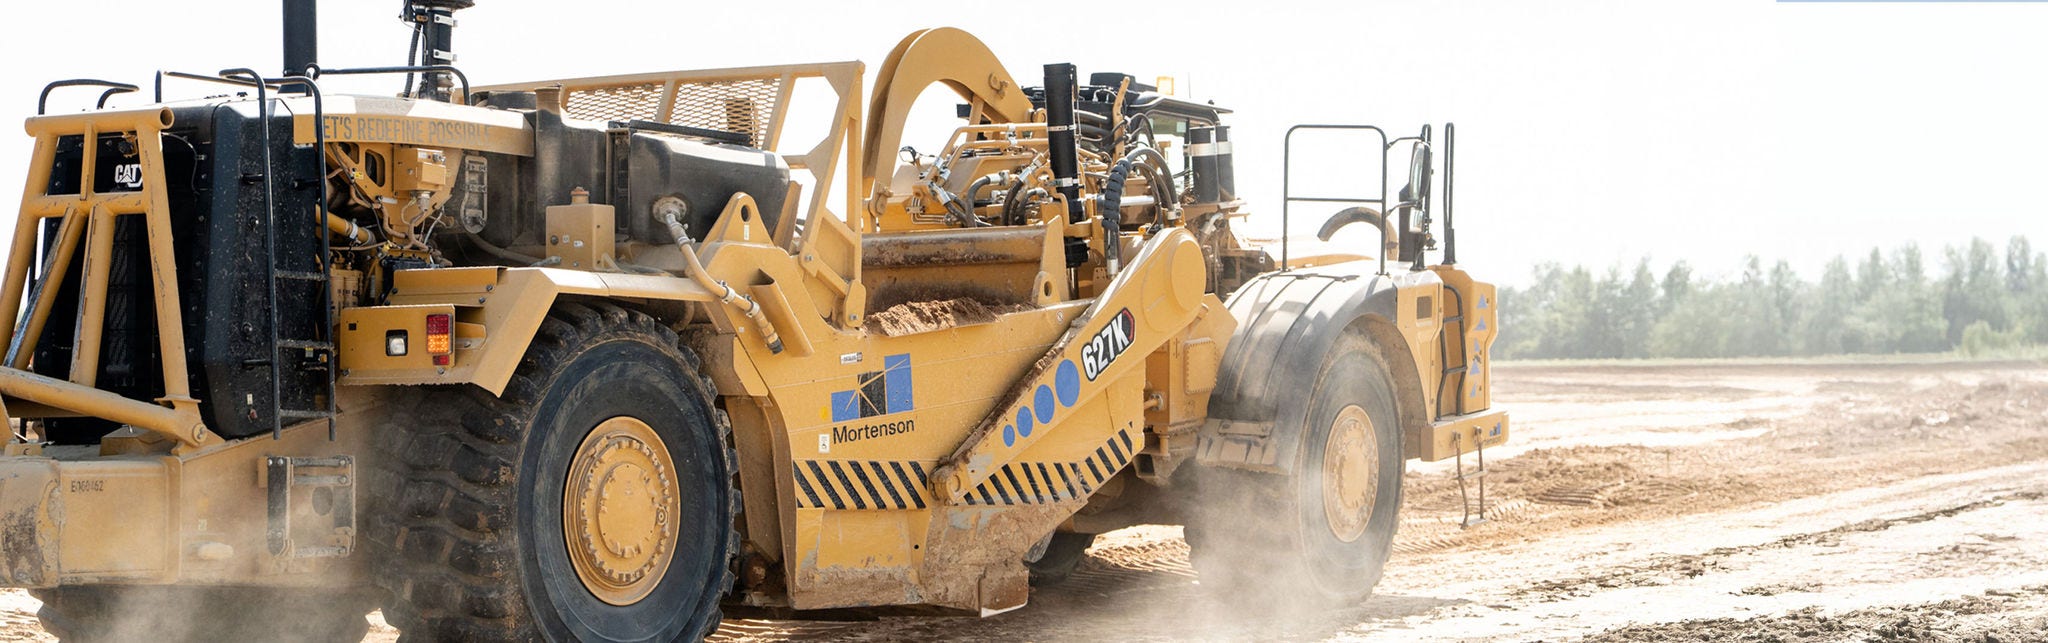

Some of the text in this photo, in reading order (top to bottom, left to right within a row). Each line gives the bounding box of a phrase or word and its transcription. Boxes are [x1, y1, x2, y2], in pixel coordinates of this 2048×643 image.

[316, 115, 352, 139] ET'S
[357, 117, 424, 142] REDEFINE
[115, 164, 138, 184] CAT
[1081, 311, 1130, 381] 627K
[832, 419, 915, 444] Mortenson
